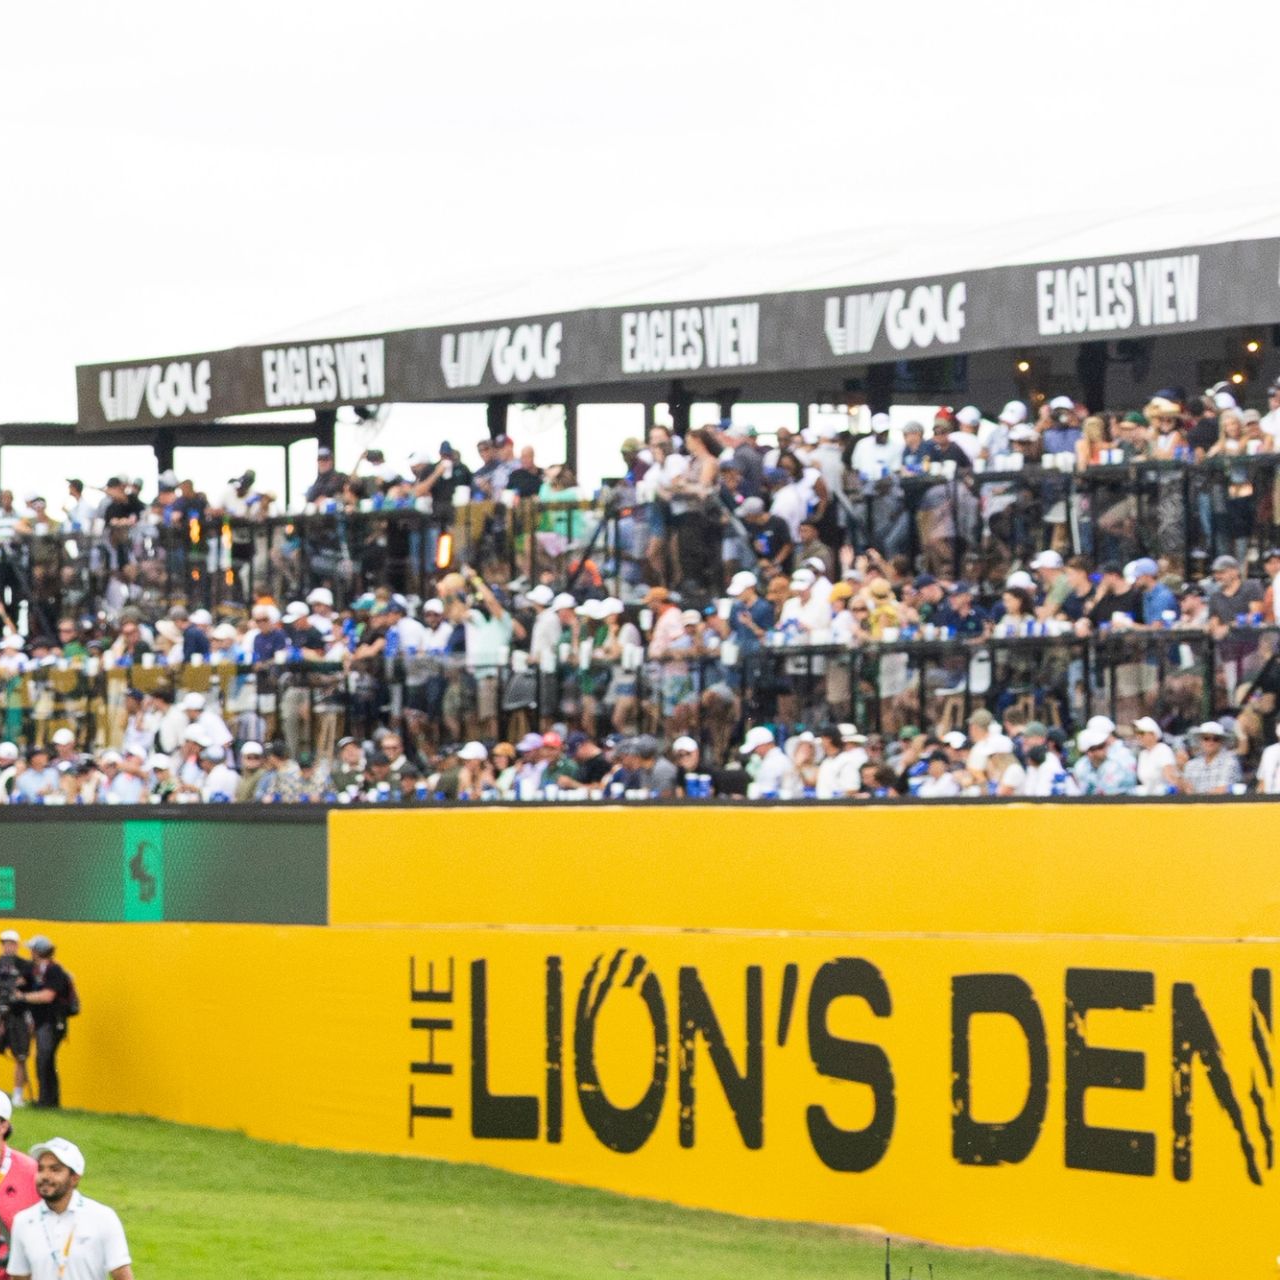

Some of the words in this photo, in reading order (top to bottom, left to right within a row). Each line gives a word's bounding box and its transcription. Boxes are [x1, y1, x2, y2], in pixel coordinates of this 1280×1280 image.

[825, 289, 890, 356] LIV
[886, 281, 966, 351] GOLF
[1037, 261, 1134, 336] EAGLES
[1134, 255, 1200, 326] VIEW
[262, 344, 337, 407] EAGLES
[335, 338, 384, 400] VIEW
[491, 321, 562, 385] GOLF
[621, 307, 703, 373] EAGLES
[702, 302, 760, 368] VIEW
[146, 359, 211, 418] GOLF
[409, 954, 455, 1138] THE
[470, 948, 897, 1174] LION'S
[950, 966, 1274, 1187] DEN
